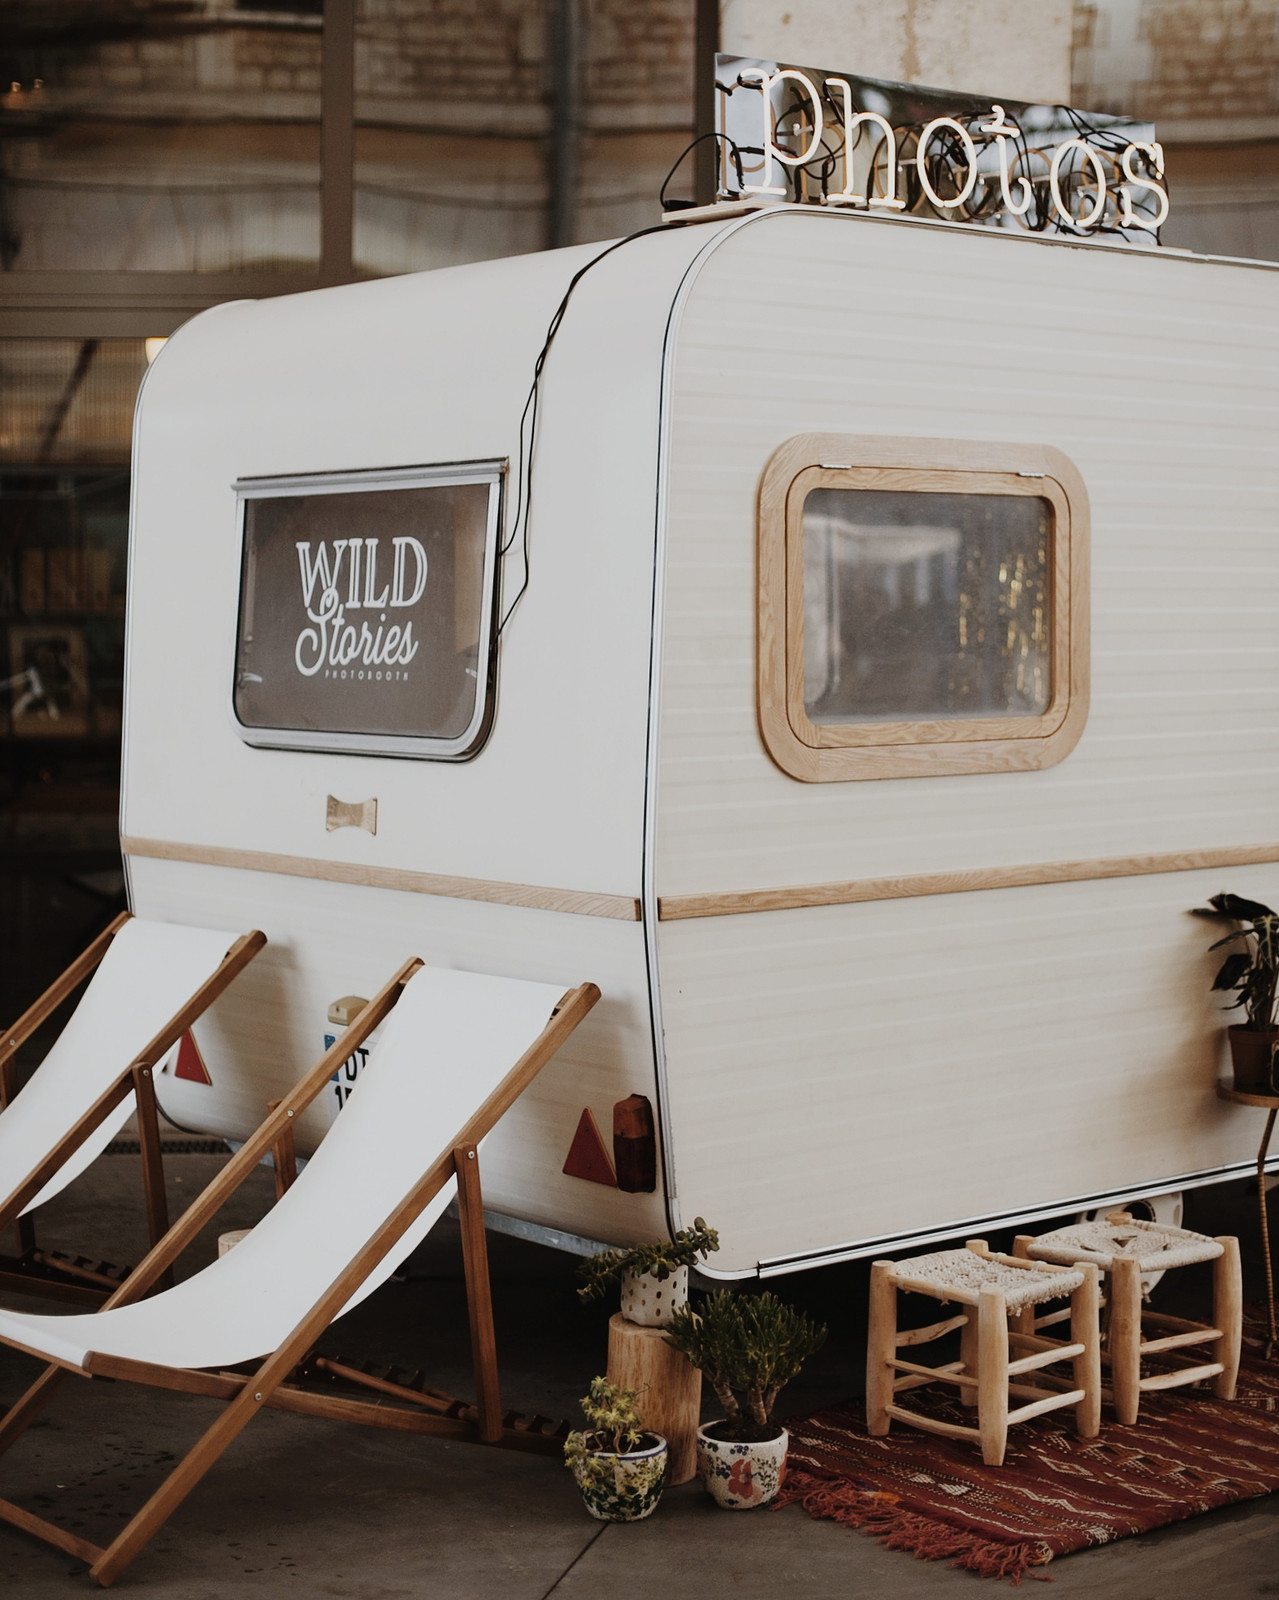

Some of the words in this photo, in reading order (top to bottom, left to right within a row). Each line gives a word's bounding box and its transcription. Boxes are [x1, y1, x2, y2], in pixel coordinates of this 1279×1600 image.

[740, 68, 1169, 228] Photos
[295, 536, 428, 608] WILD
[295, 588, 419, 676] Stories
[325, 669, 409, 681] PHOTOBOOTH
